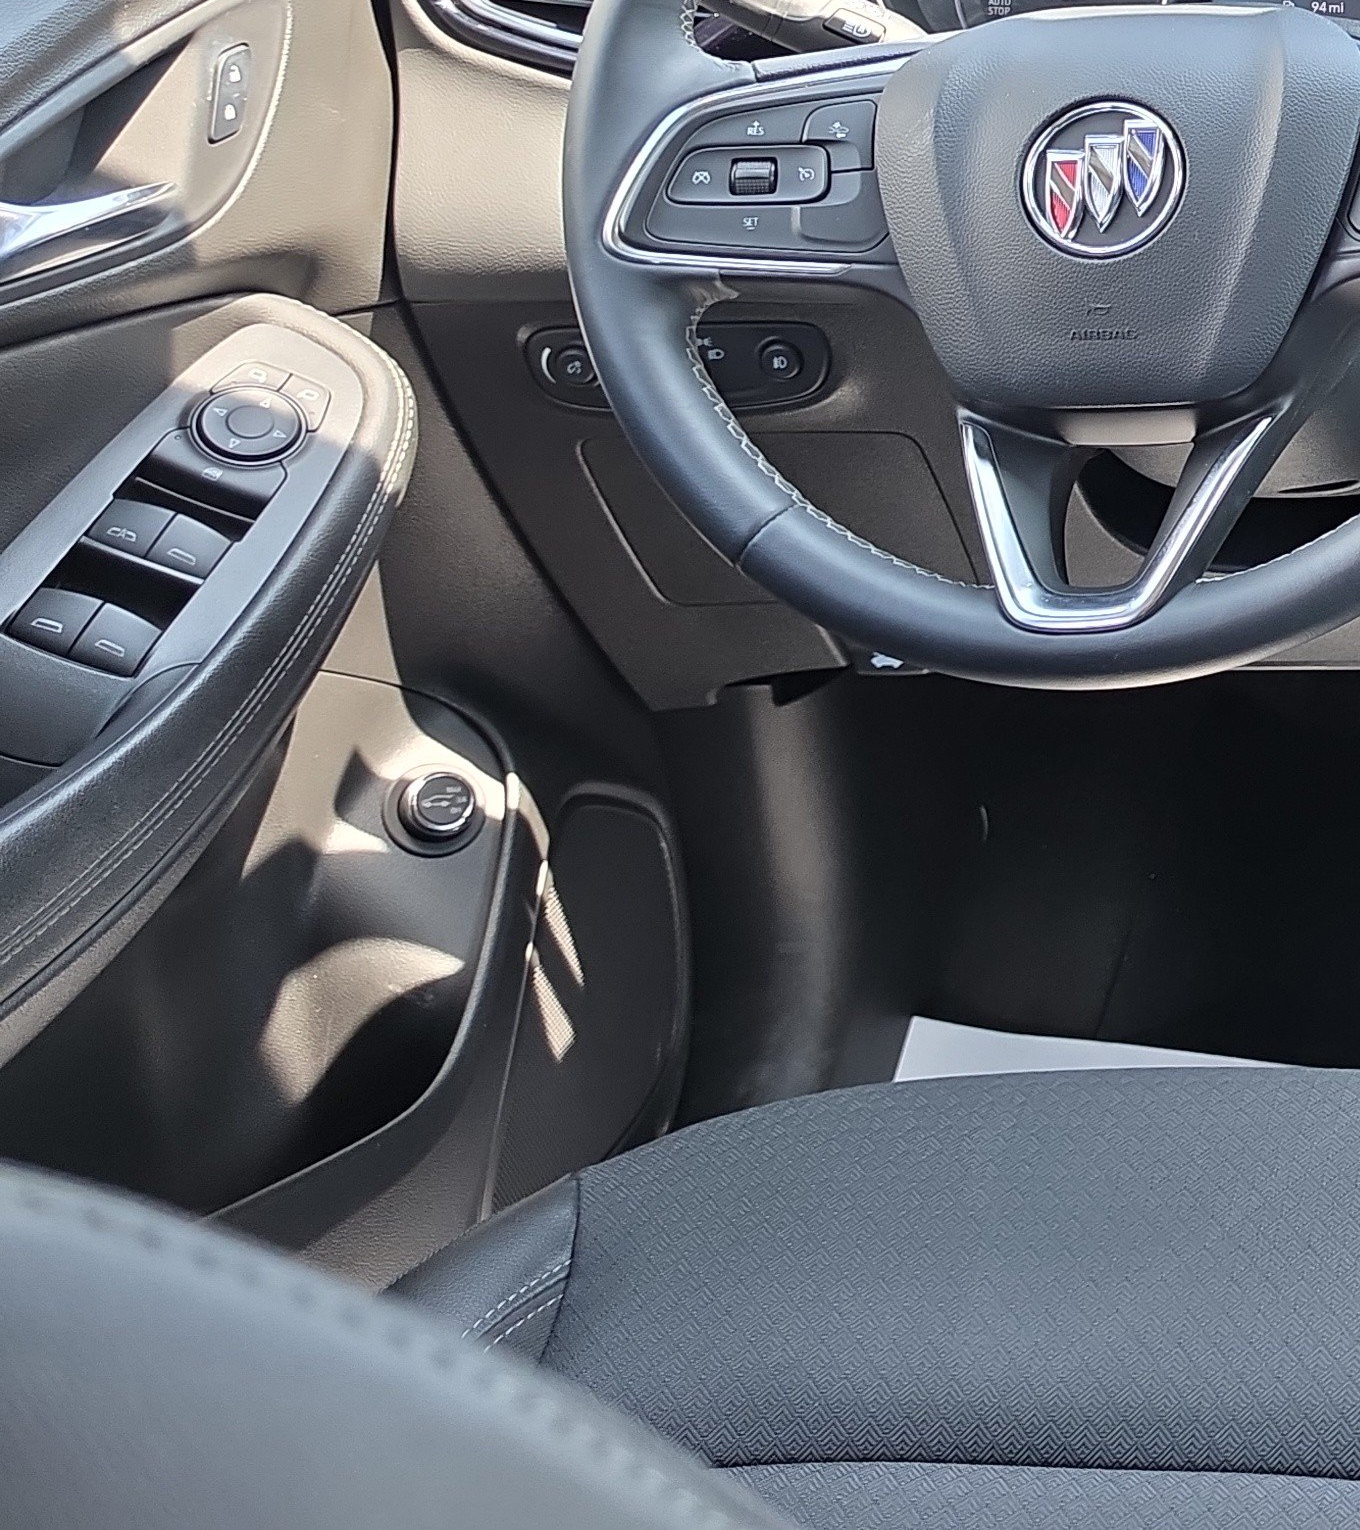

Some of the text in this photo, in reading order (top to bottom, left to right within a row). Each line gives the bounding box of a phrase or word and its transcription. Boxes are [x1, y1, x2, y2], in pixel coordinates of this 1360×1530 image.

[987, 6, 1011, 15] STOP
[1311, 1, 1345, 13] 94 mi
[746, 126, 765, 136] RES
[742, 216, 759, 227] SET
[1070, 329, 1139, 341] AIRBAG
